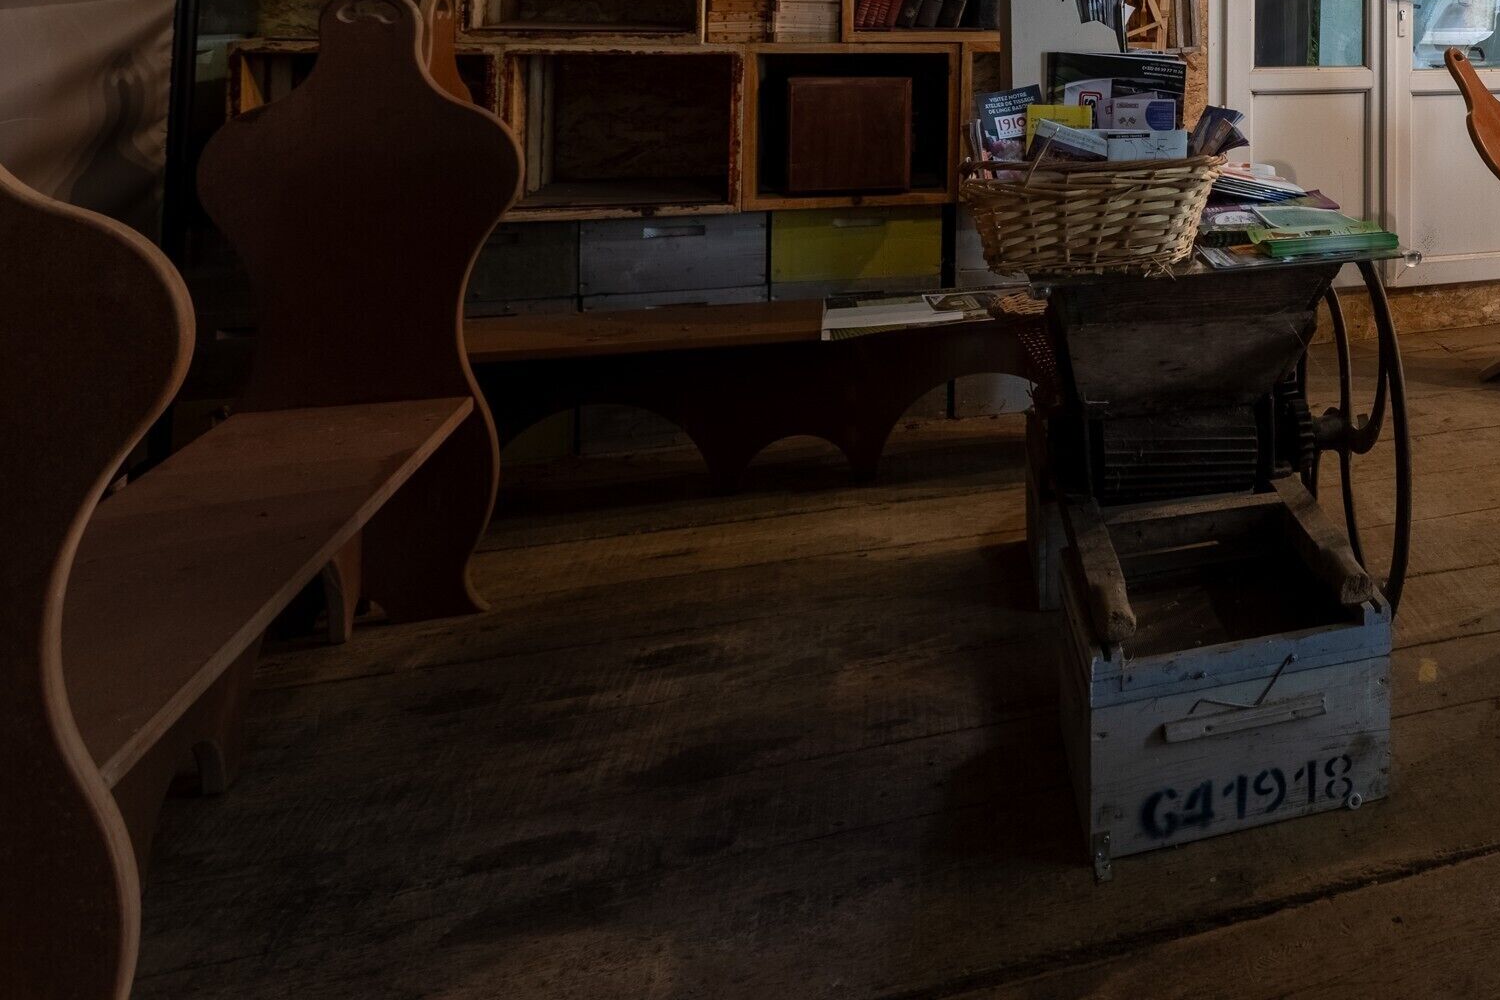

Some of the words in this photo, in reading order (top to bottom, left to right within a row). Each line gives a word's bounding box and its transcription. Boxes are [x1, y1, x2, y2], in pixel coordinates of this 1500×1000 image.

[985, 101, 1005, 109] ATELIER
[1013, 96, 1035, 105] TISSAGE
[988, 95, 1008, 103] VISITEZ
[1008, 91, 1027, 100] NOTRE
[996, 106, 1012, 114] LINGE
[998, 117, 1027, 131] 1910
[1138, 753, 1354, 840] G41918
